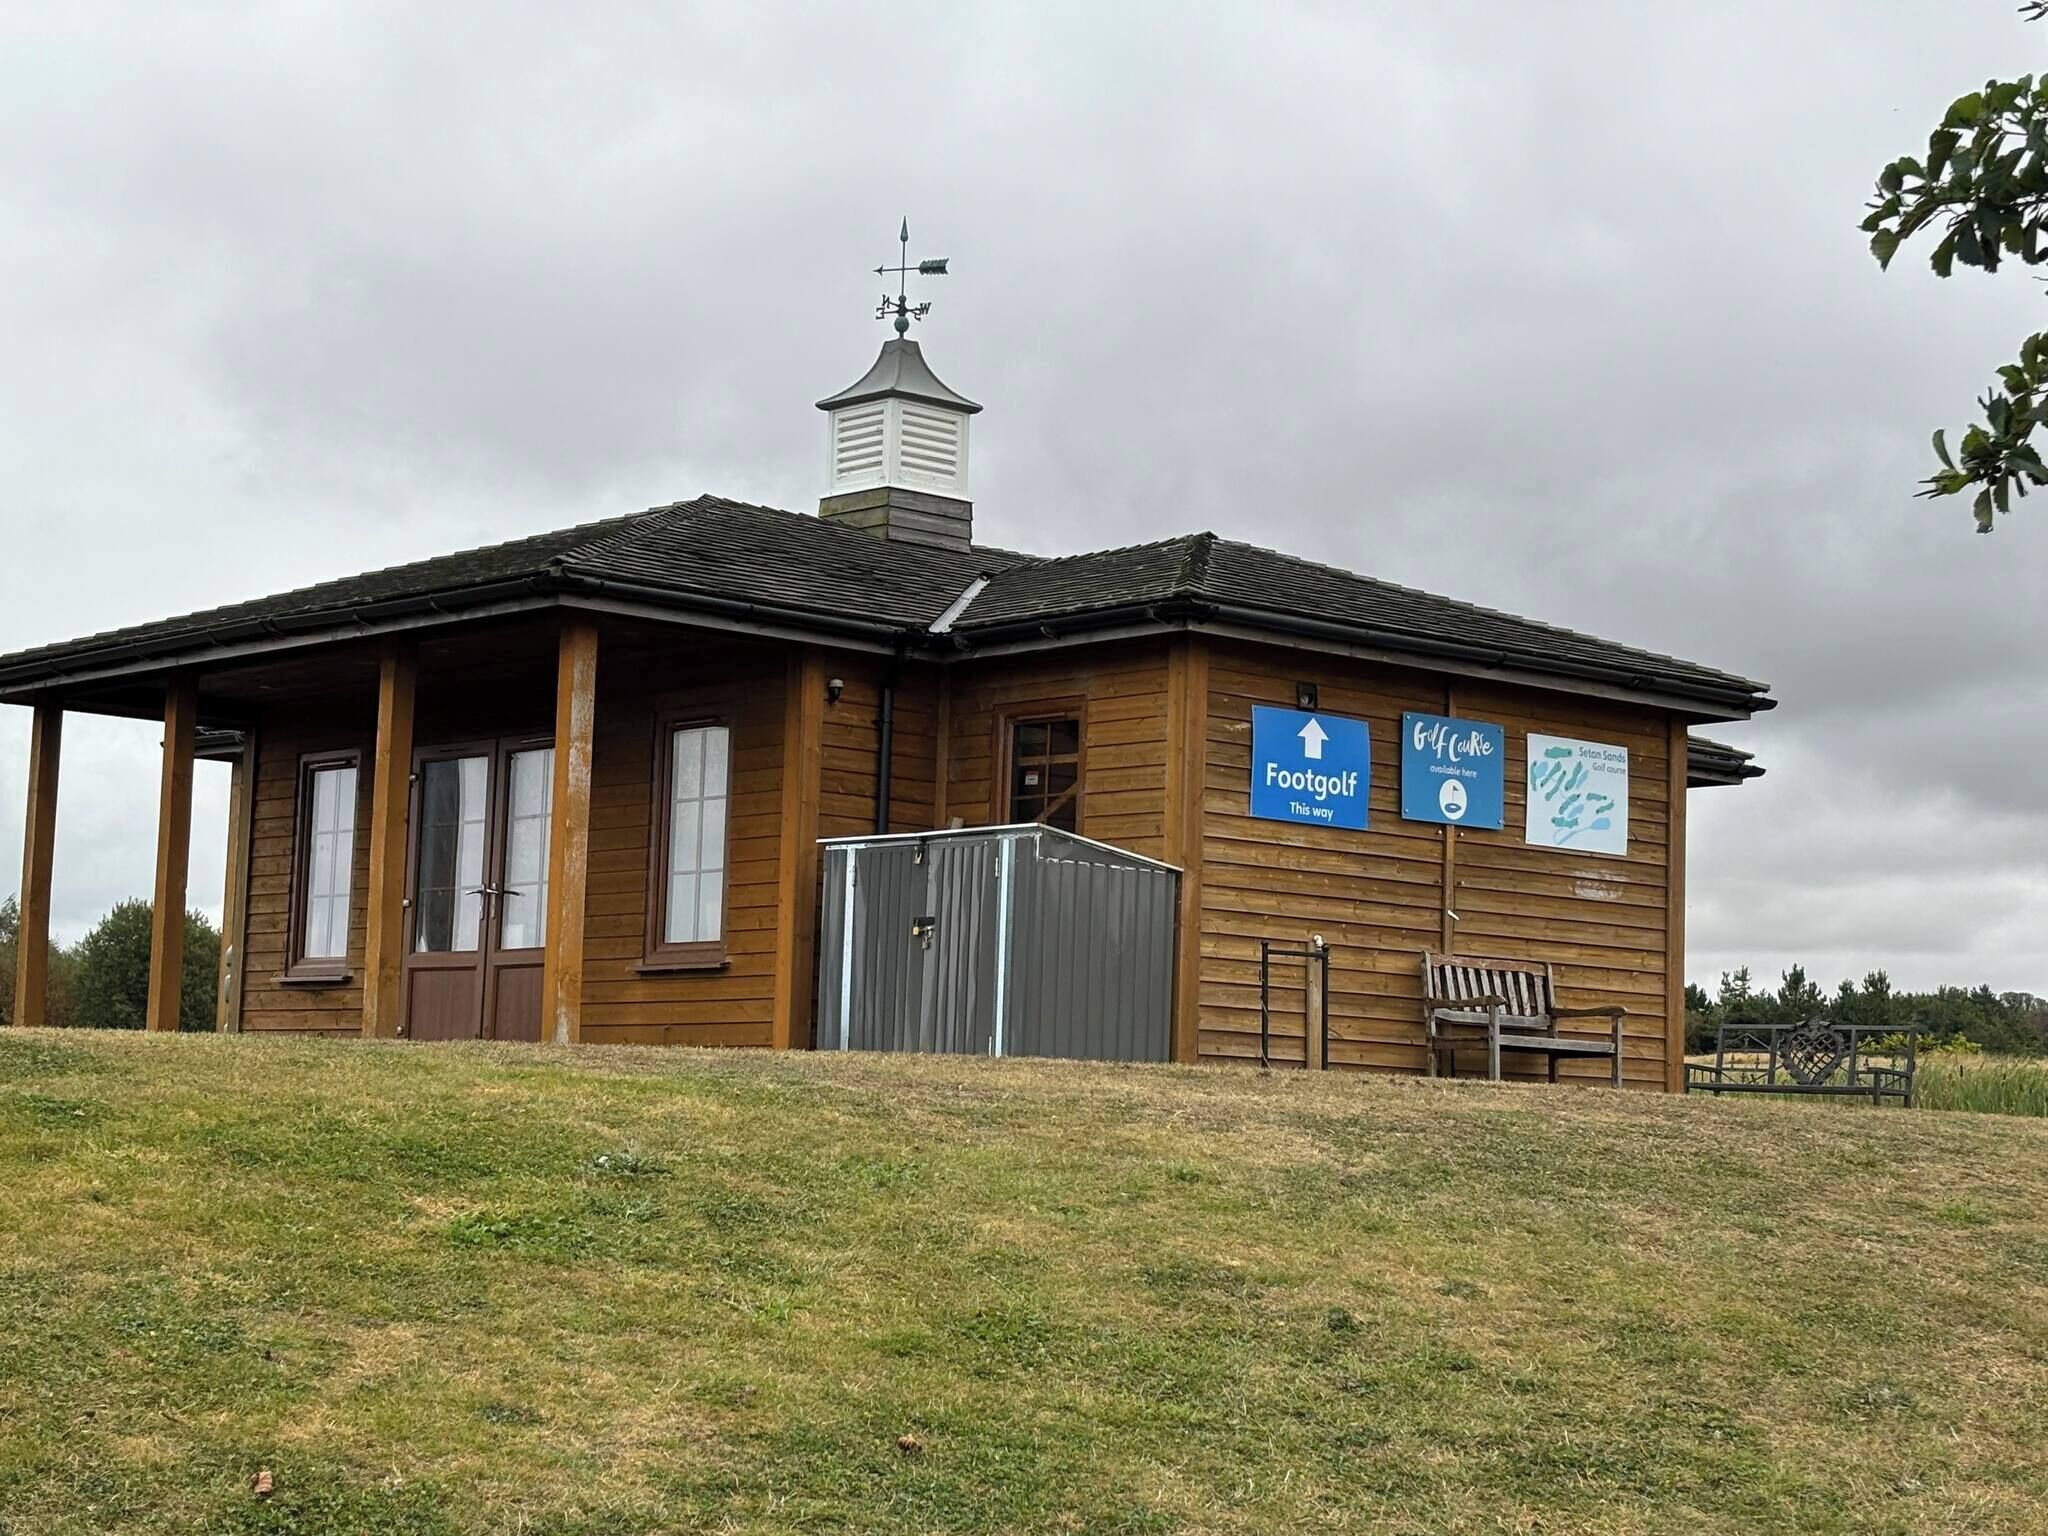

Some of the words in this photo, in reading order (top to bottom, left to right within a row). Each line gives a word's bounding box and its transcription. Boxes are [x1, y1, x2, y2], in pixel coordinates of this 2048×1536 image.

[919, 302, 931, 315] W
[1413, 721, 1449, 759] Golf
[1602, 750, 1626, 763] Sands
[1429, 765, 1460, 776] available
[1461, 767, 1477, 778] here
[1592, 761, 1606, 772] Golf
[1266, 762, 1358, 801] Footgolf
[1289, 801, 1310, 816] This
[1312, 807, 1334, 822] way
